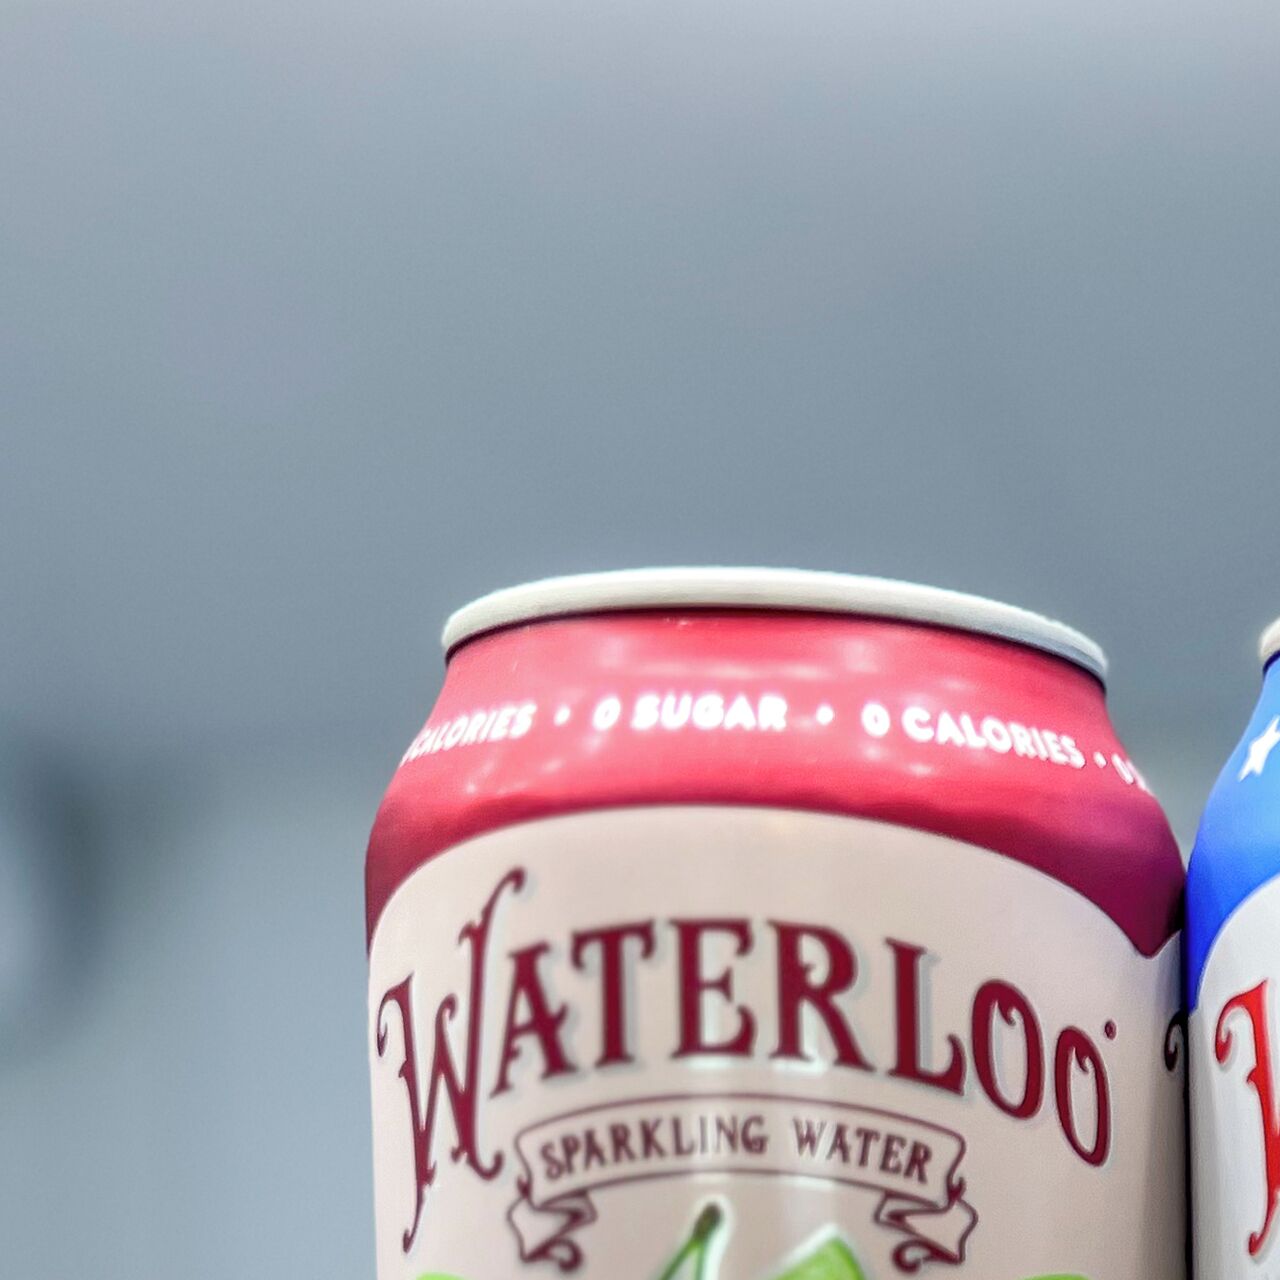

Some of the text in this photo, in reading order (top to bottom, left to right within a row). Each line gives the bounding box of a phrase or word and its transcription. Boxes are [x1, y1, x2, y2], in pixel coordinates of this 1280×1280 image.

[592, 695, 621, 732] 0
[630, 692, 788, 732] SUGAR
[861, 702, 890, 738] 0
[901, 704, 1085, 770] CALORIES
[378, 865, 1111, 1253] WATERLOO
[540, 1115, 933, 1185] SPARKLING WATER
